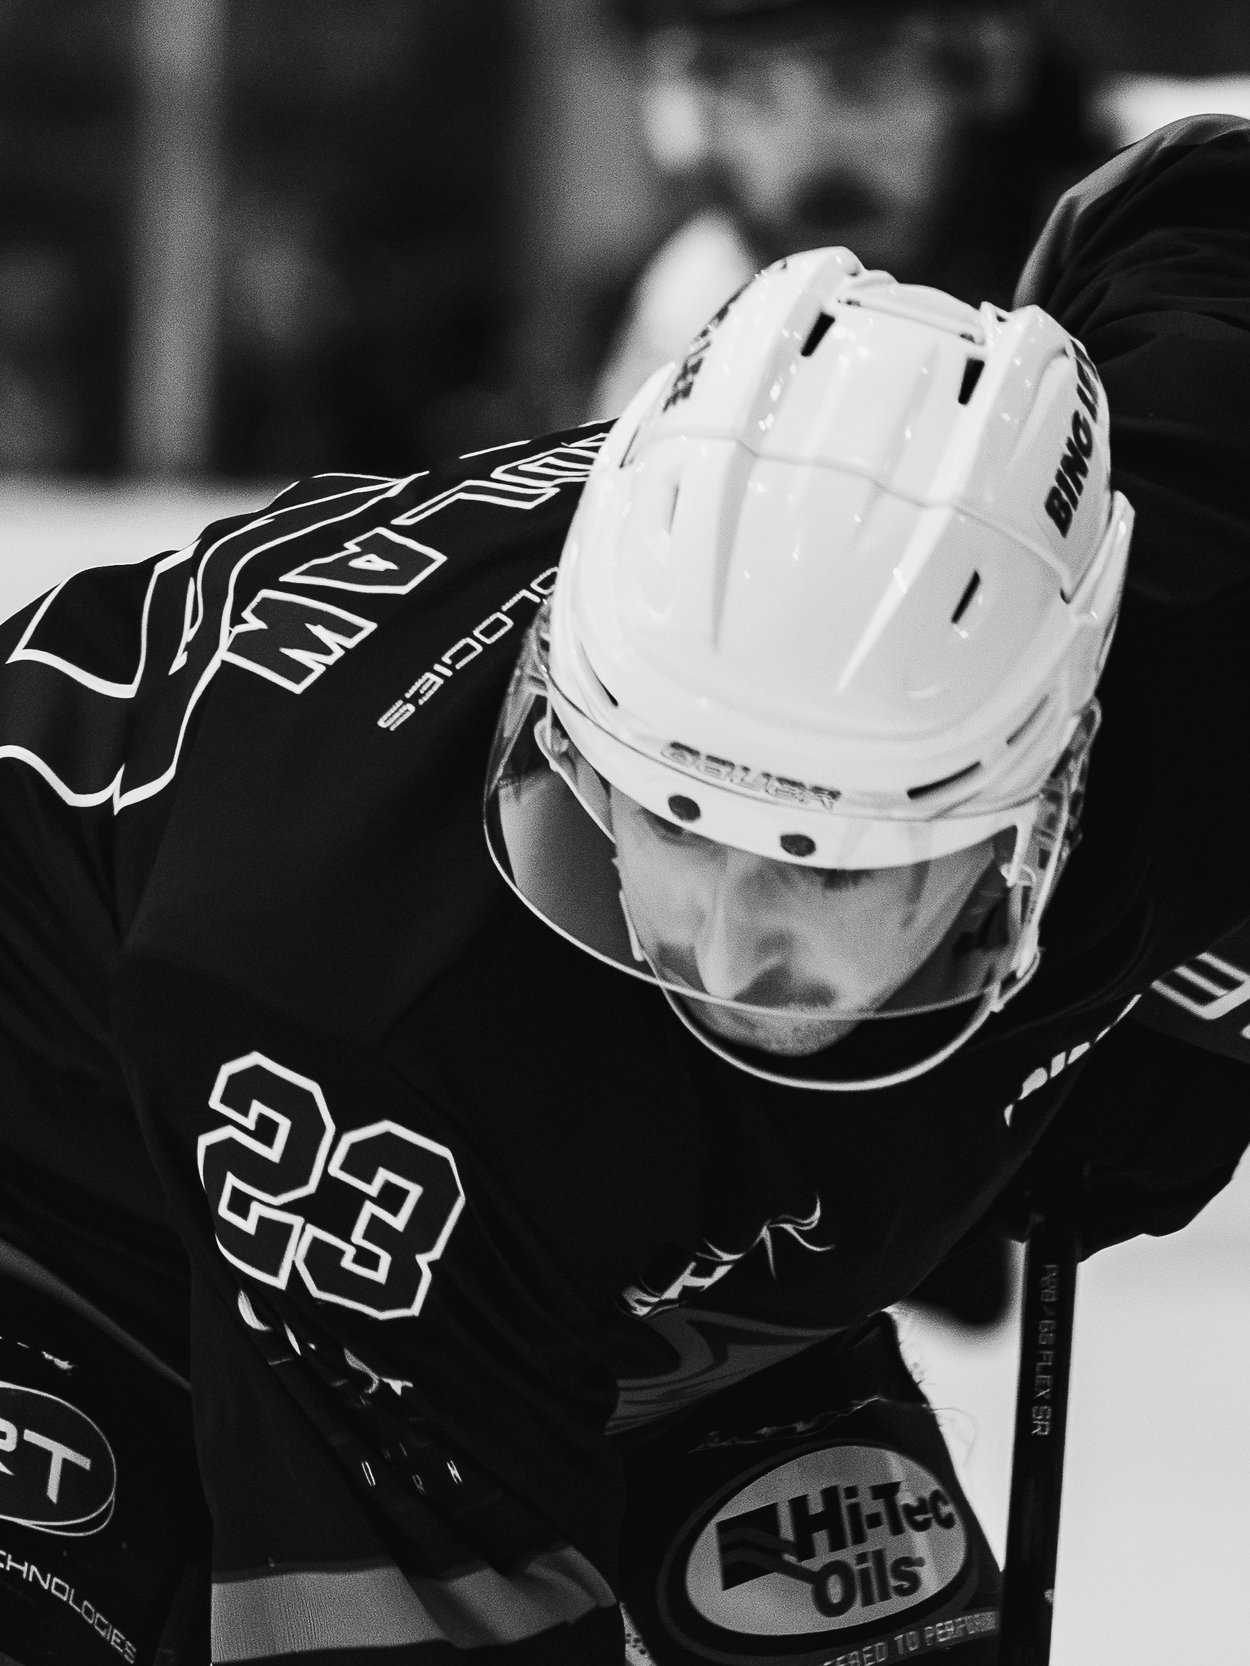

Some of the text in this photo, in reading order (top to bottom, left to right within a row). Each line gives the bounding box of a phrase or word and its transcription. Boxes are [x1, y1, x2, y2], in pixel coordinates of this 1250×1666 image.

[198, 1051, 466, 1320] 23
[1034, 1350, 1055, 1399] FLEX
[1030, 1404, 1051, 1436] SR
[788, 1481, 956, 1561] Hi-Tec
[812, 1548, 925, 1617] Oils
[894, 1630, 921, 1654] TO
